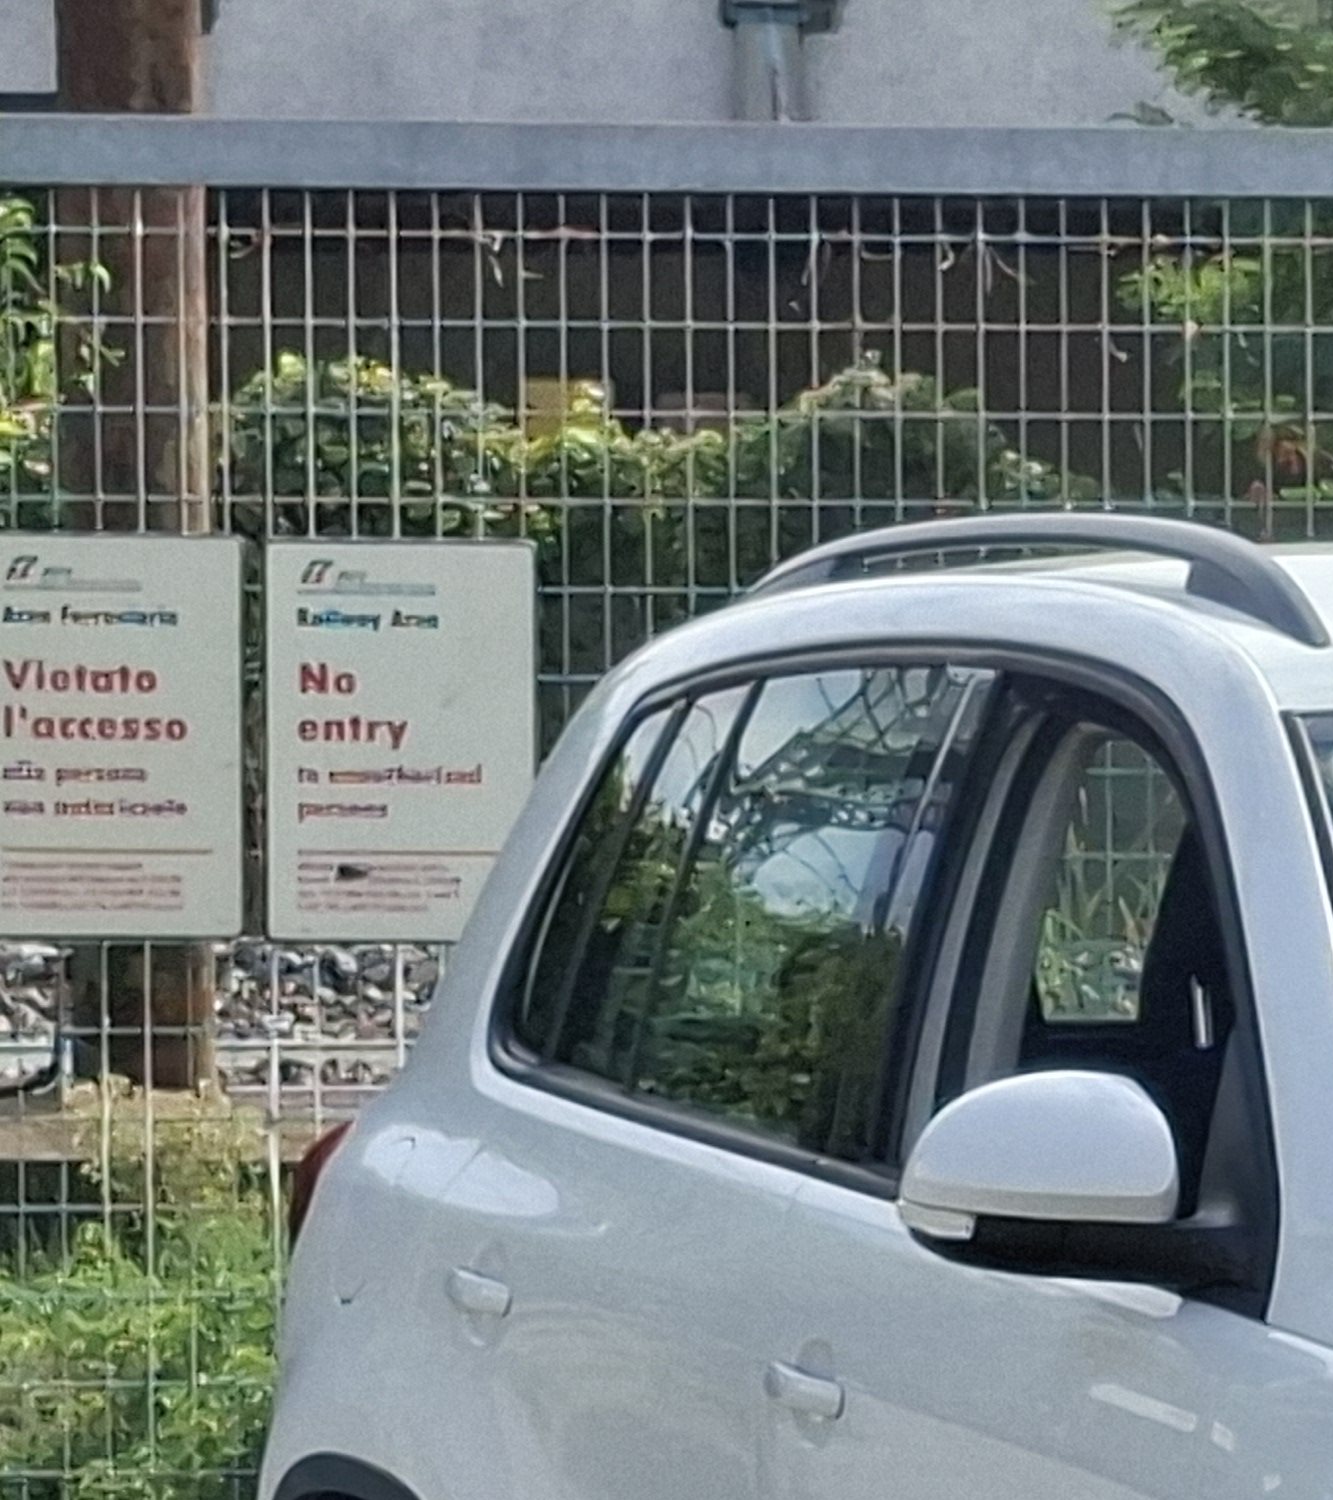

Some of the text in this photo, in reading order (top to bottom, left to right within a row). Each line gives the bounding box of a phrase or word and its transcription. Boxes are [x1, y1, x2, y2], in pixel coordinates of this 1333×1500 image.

[3, 659, 158, 694] Vietato
[299, 662, 358, 695] No
[3, 704, 188, 741] l'accesso
[297, 715, 409, 750] entry
